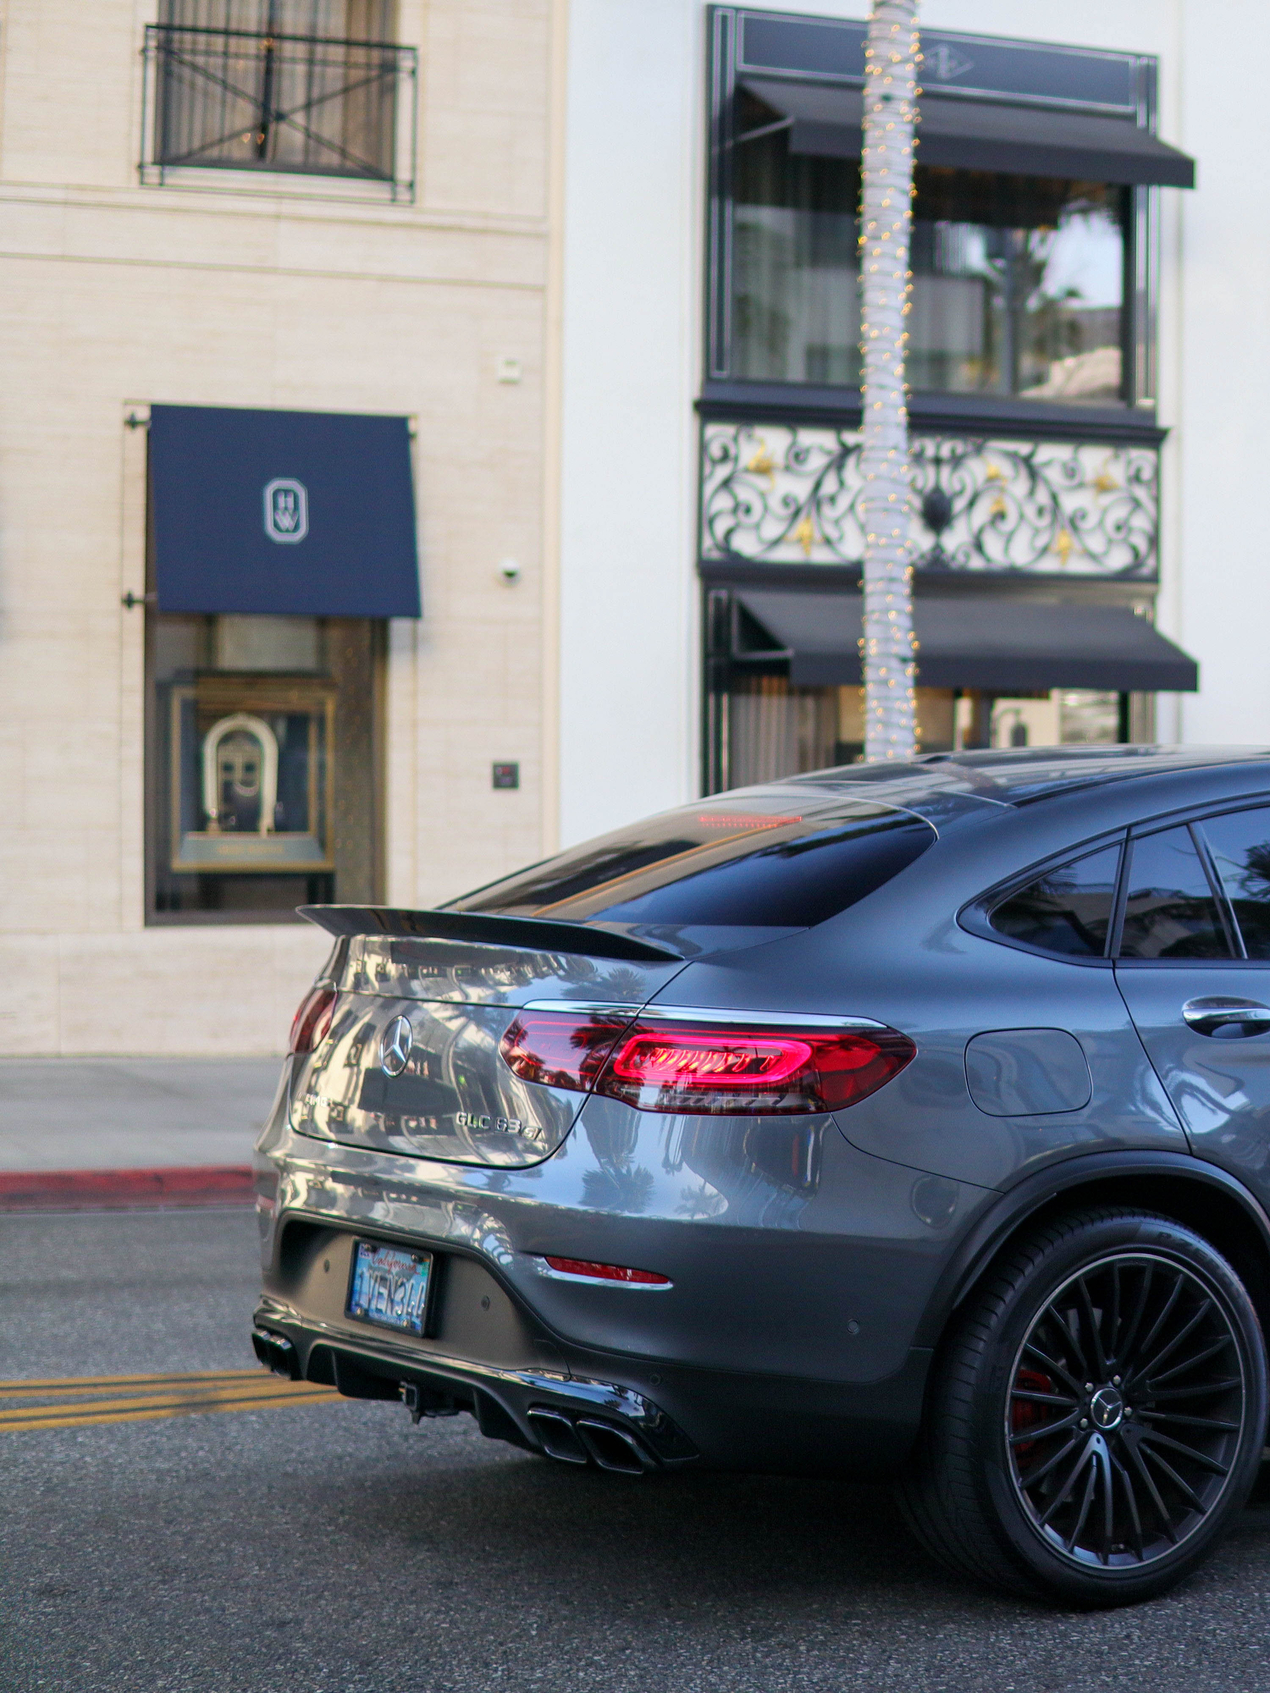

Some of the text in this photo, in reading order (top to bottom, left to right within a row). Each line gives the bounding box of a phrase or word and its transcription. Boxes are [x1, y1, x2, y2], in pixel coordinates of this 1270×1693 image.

[456, 1111, 492, 1130] GLC
[495, 1116, 523, 1134] 63
[372, 1247, 421, 1275] California
